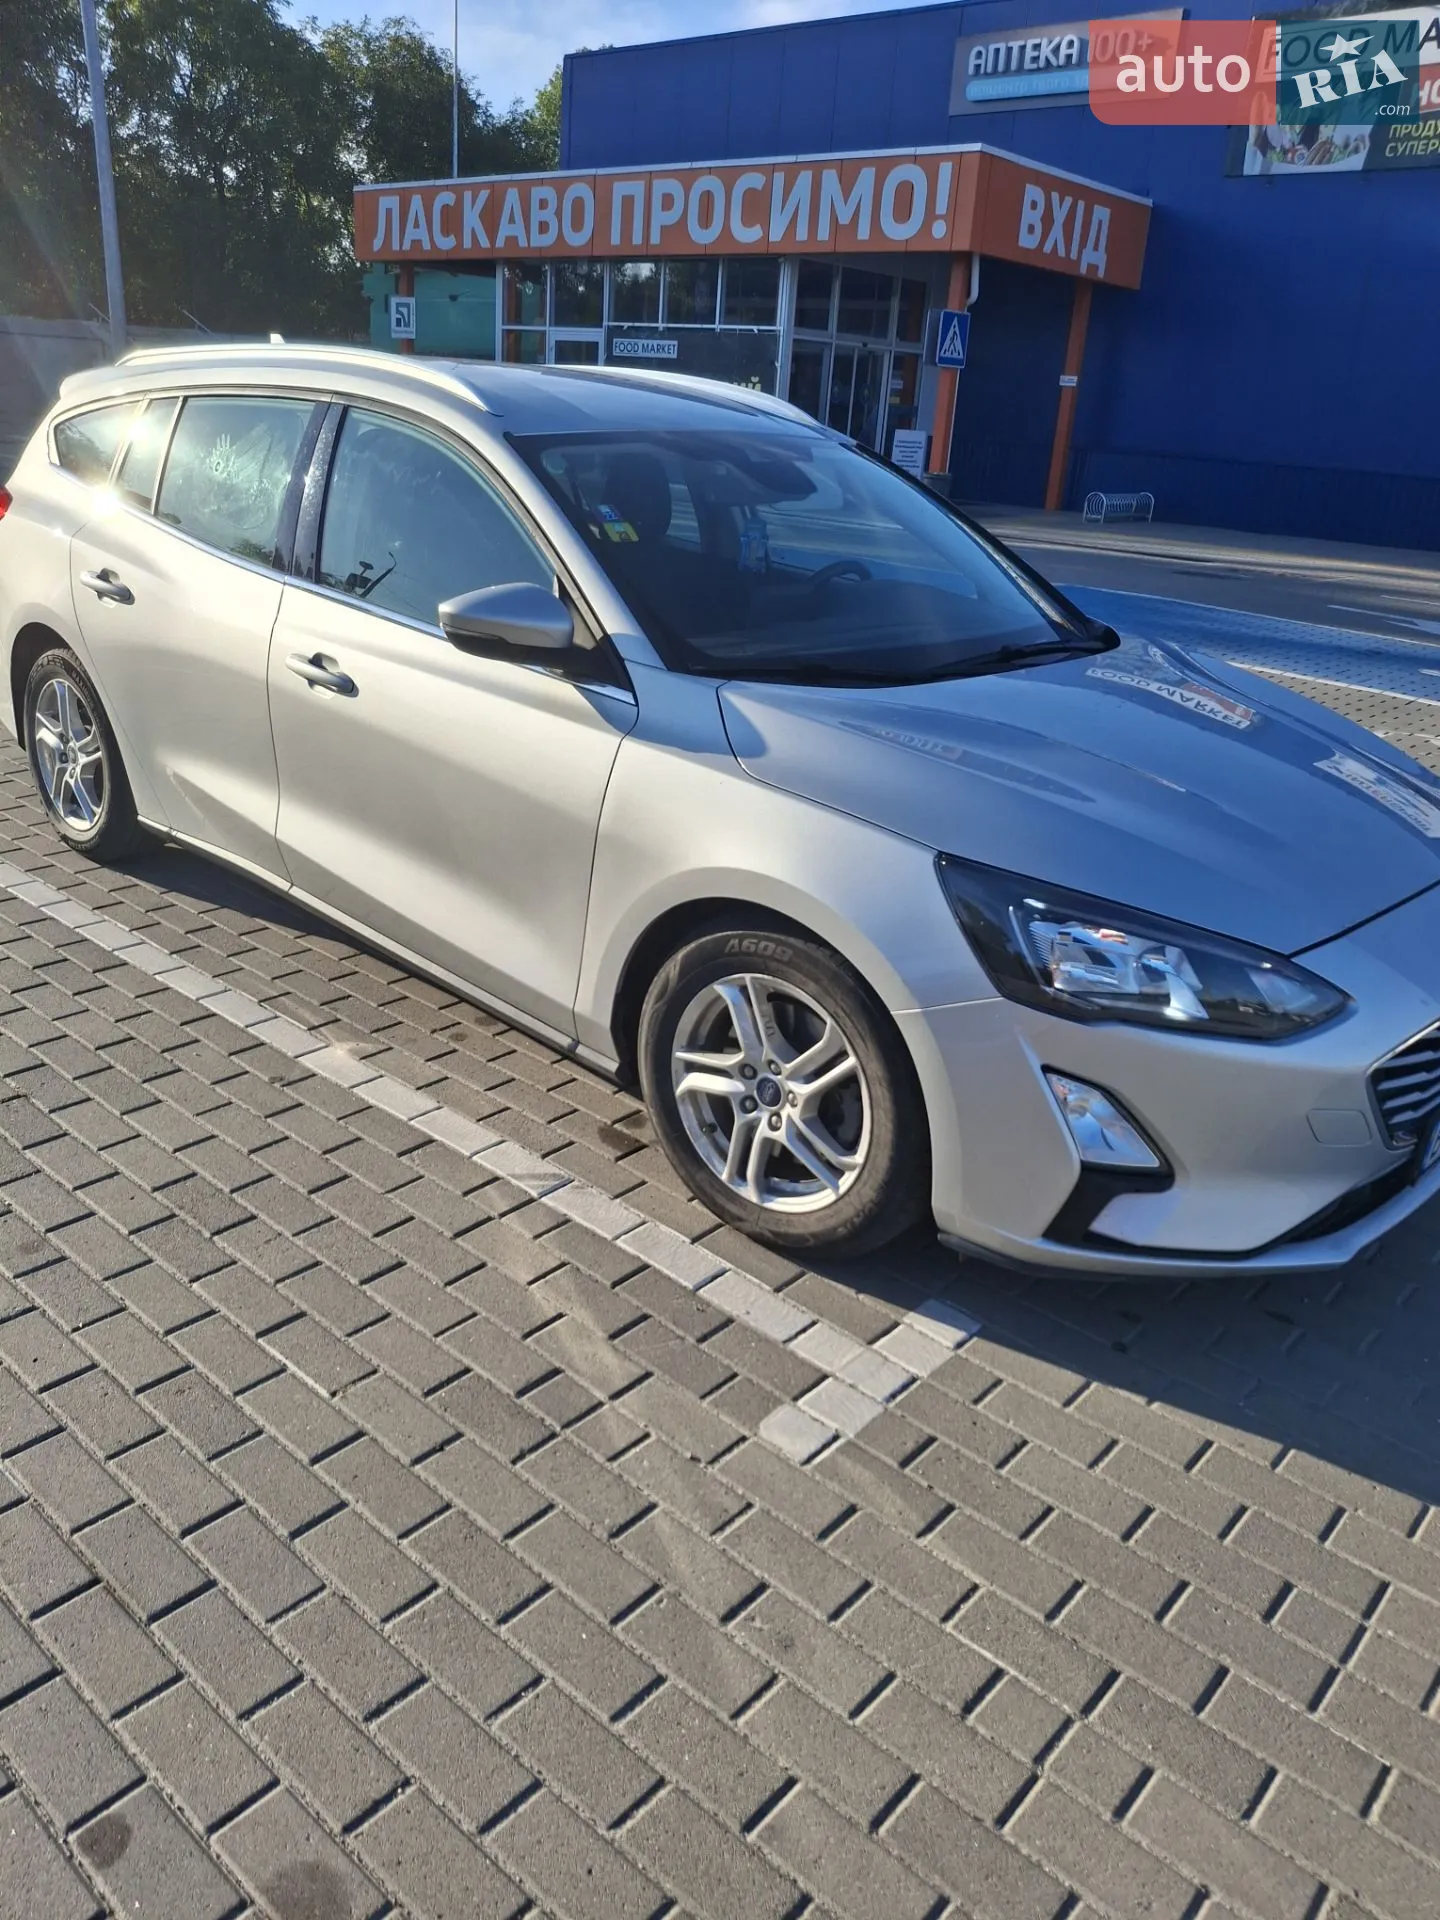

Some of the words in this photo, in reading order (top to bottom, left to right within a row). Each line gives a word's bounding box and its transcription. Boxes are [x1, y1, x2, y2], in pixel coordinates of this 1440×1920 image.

[968, 34, 1081, 75] АПТЕКА
[1385, 138, 1440, 157] СУПЕР
[373, 182, 595, 252] ЛАСКАВО
[611, 161, 953, 246] ПРОСИМО!
[1018, 183, 1111, 277] ВХІД
[614, 341, 640, 354] FOOD
[641, 342, 677, 355] MARKET
[725, 938, 793, 963] A609
